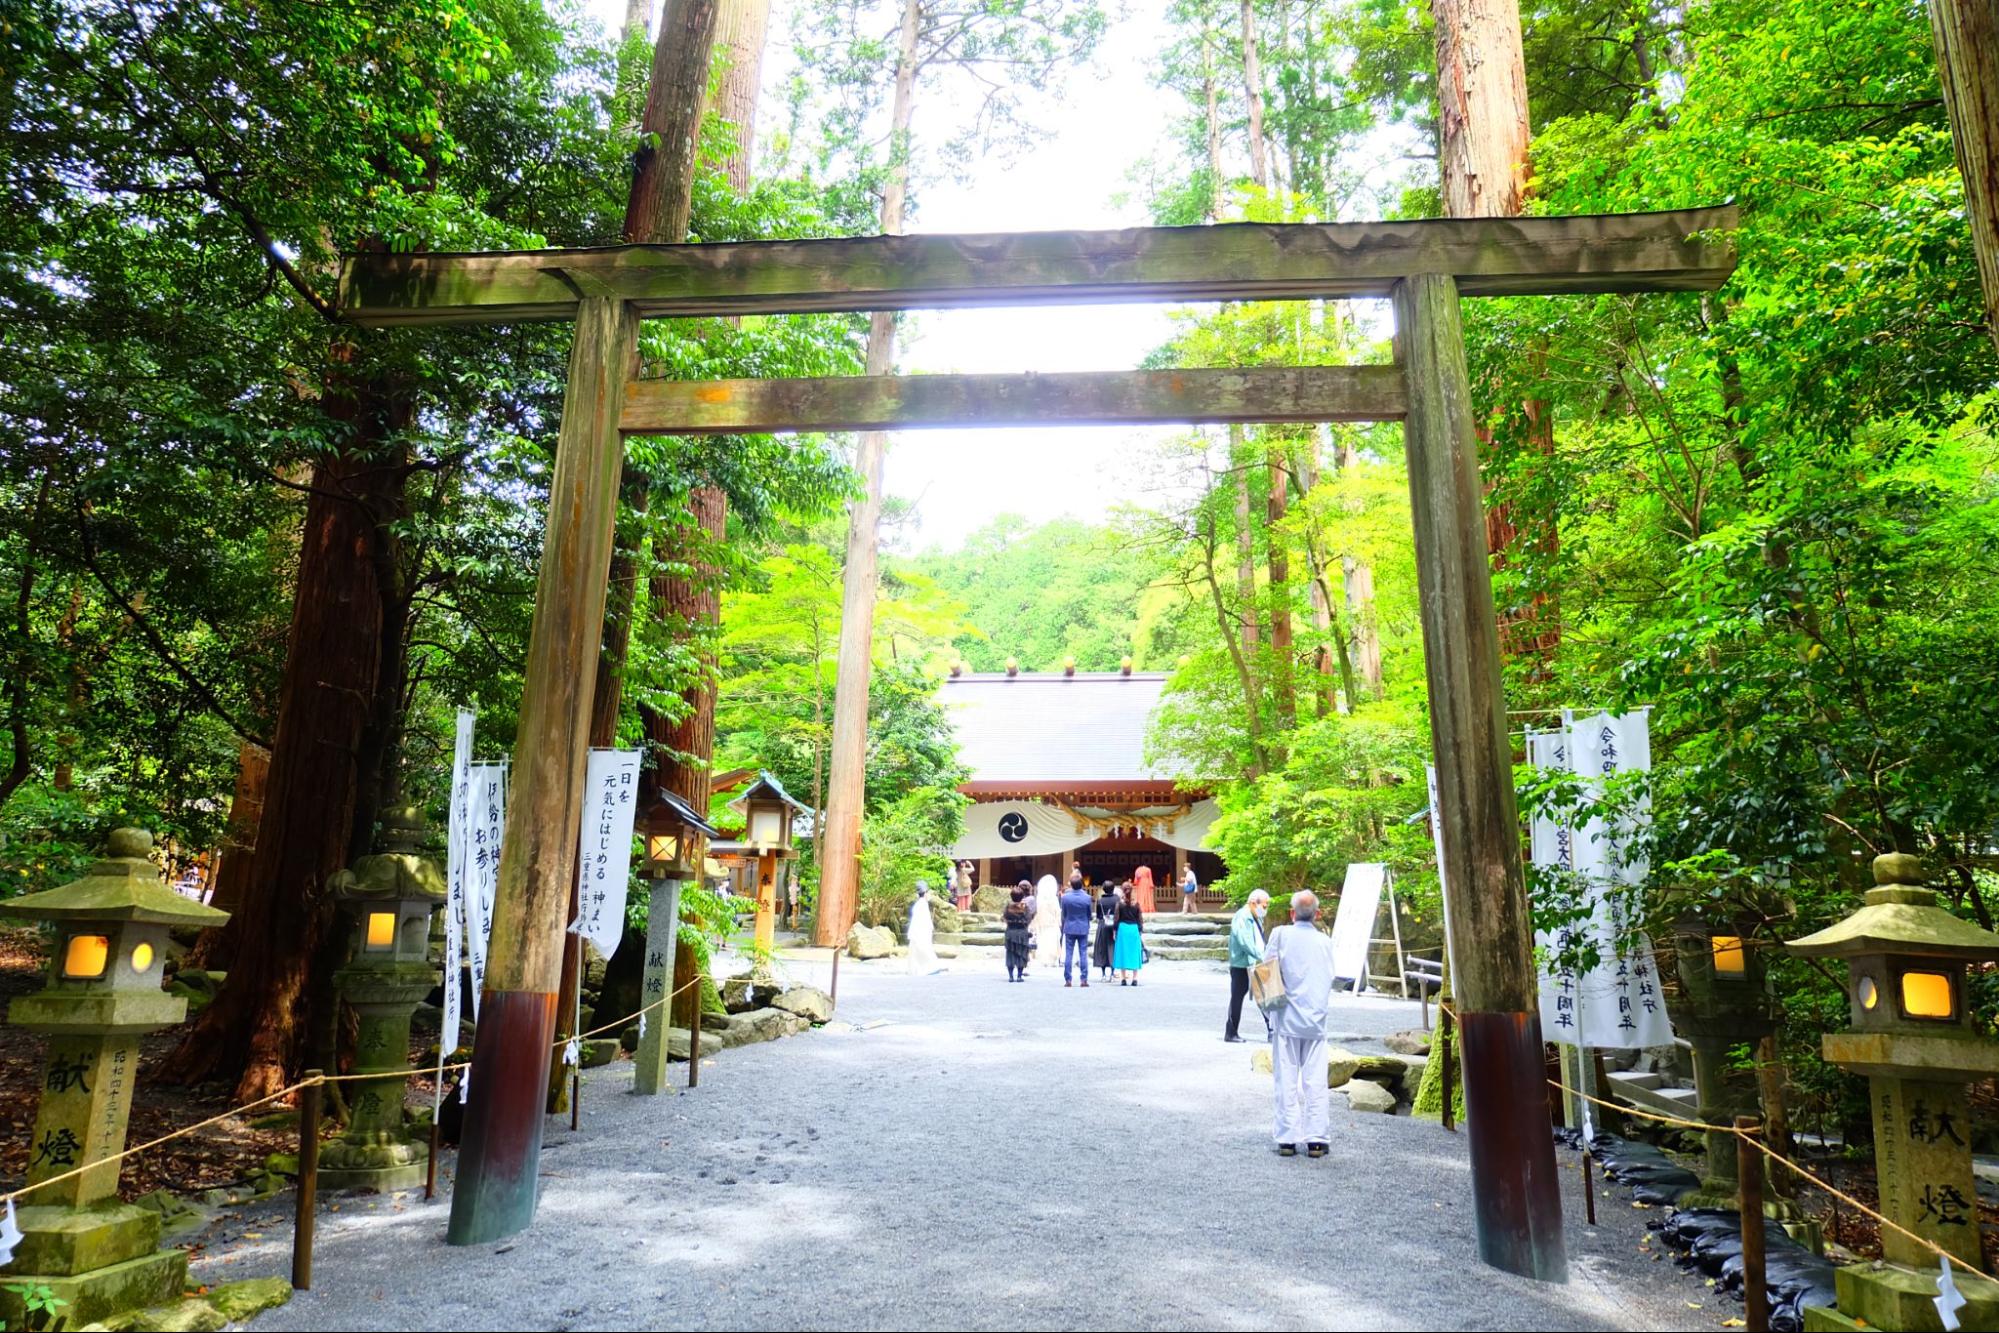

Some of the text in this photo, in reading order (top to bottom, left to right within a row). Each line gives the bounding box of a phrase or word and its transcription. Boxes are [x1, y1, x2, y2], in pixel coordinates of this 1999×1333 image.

[596, 775, 617, 880] 元気にはじめる
[619, 762, 634, 803] 一日を
[475, 828, 490, 943] お参りしま
[33, 1053, 93, 1166] 献燈
[1909, 1099, 1970, 1226] 献燈
